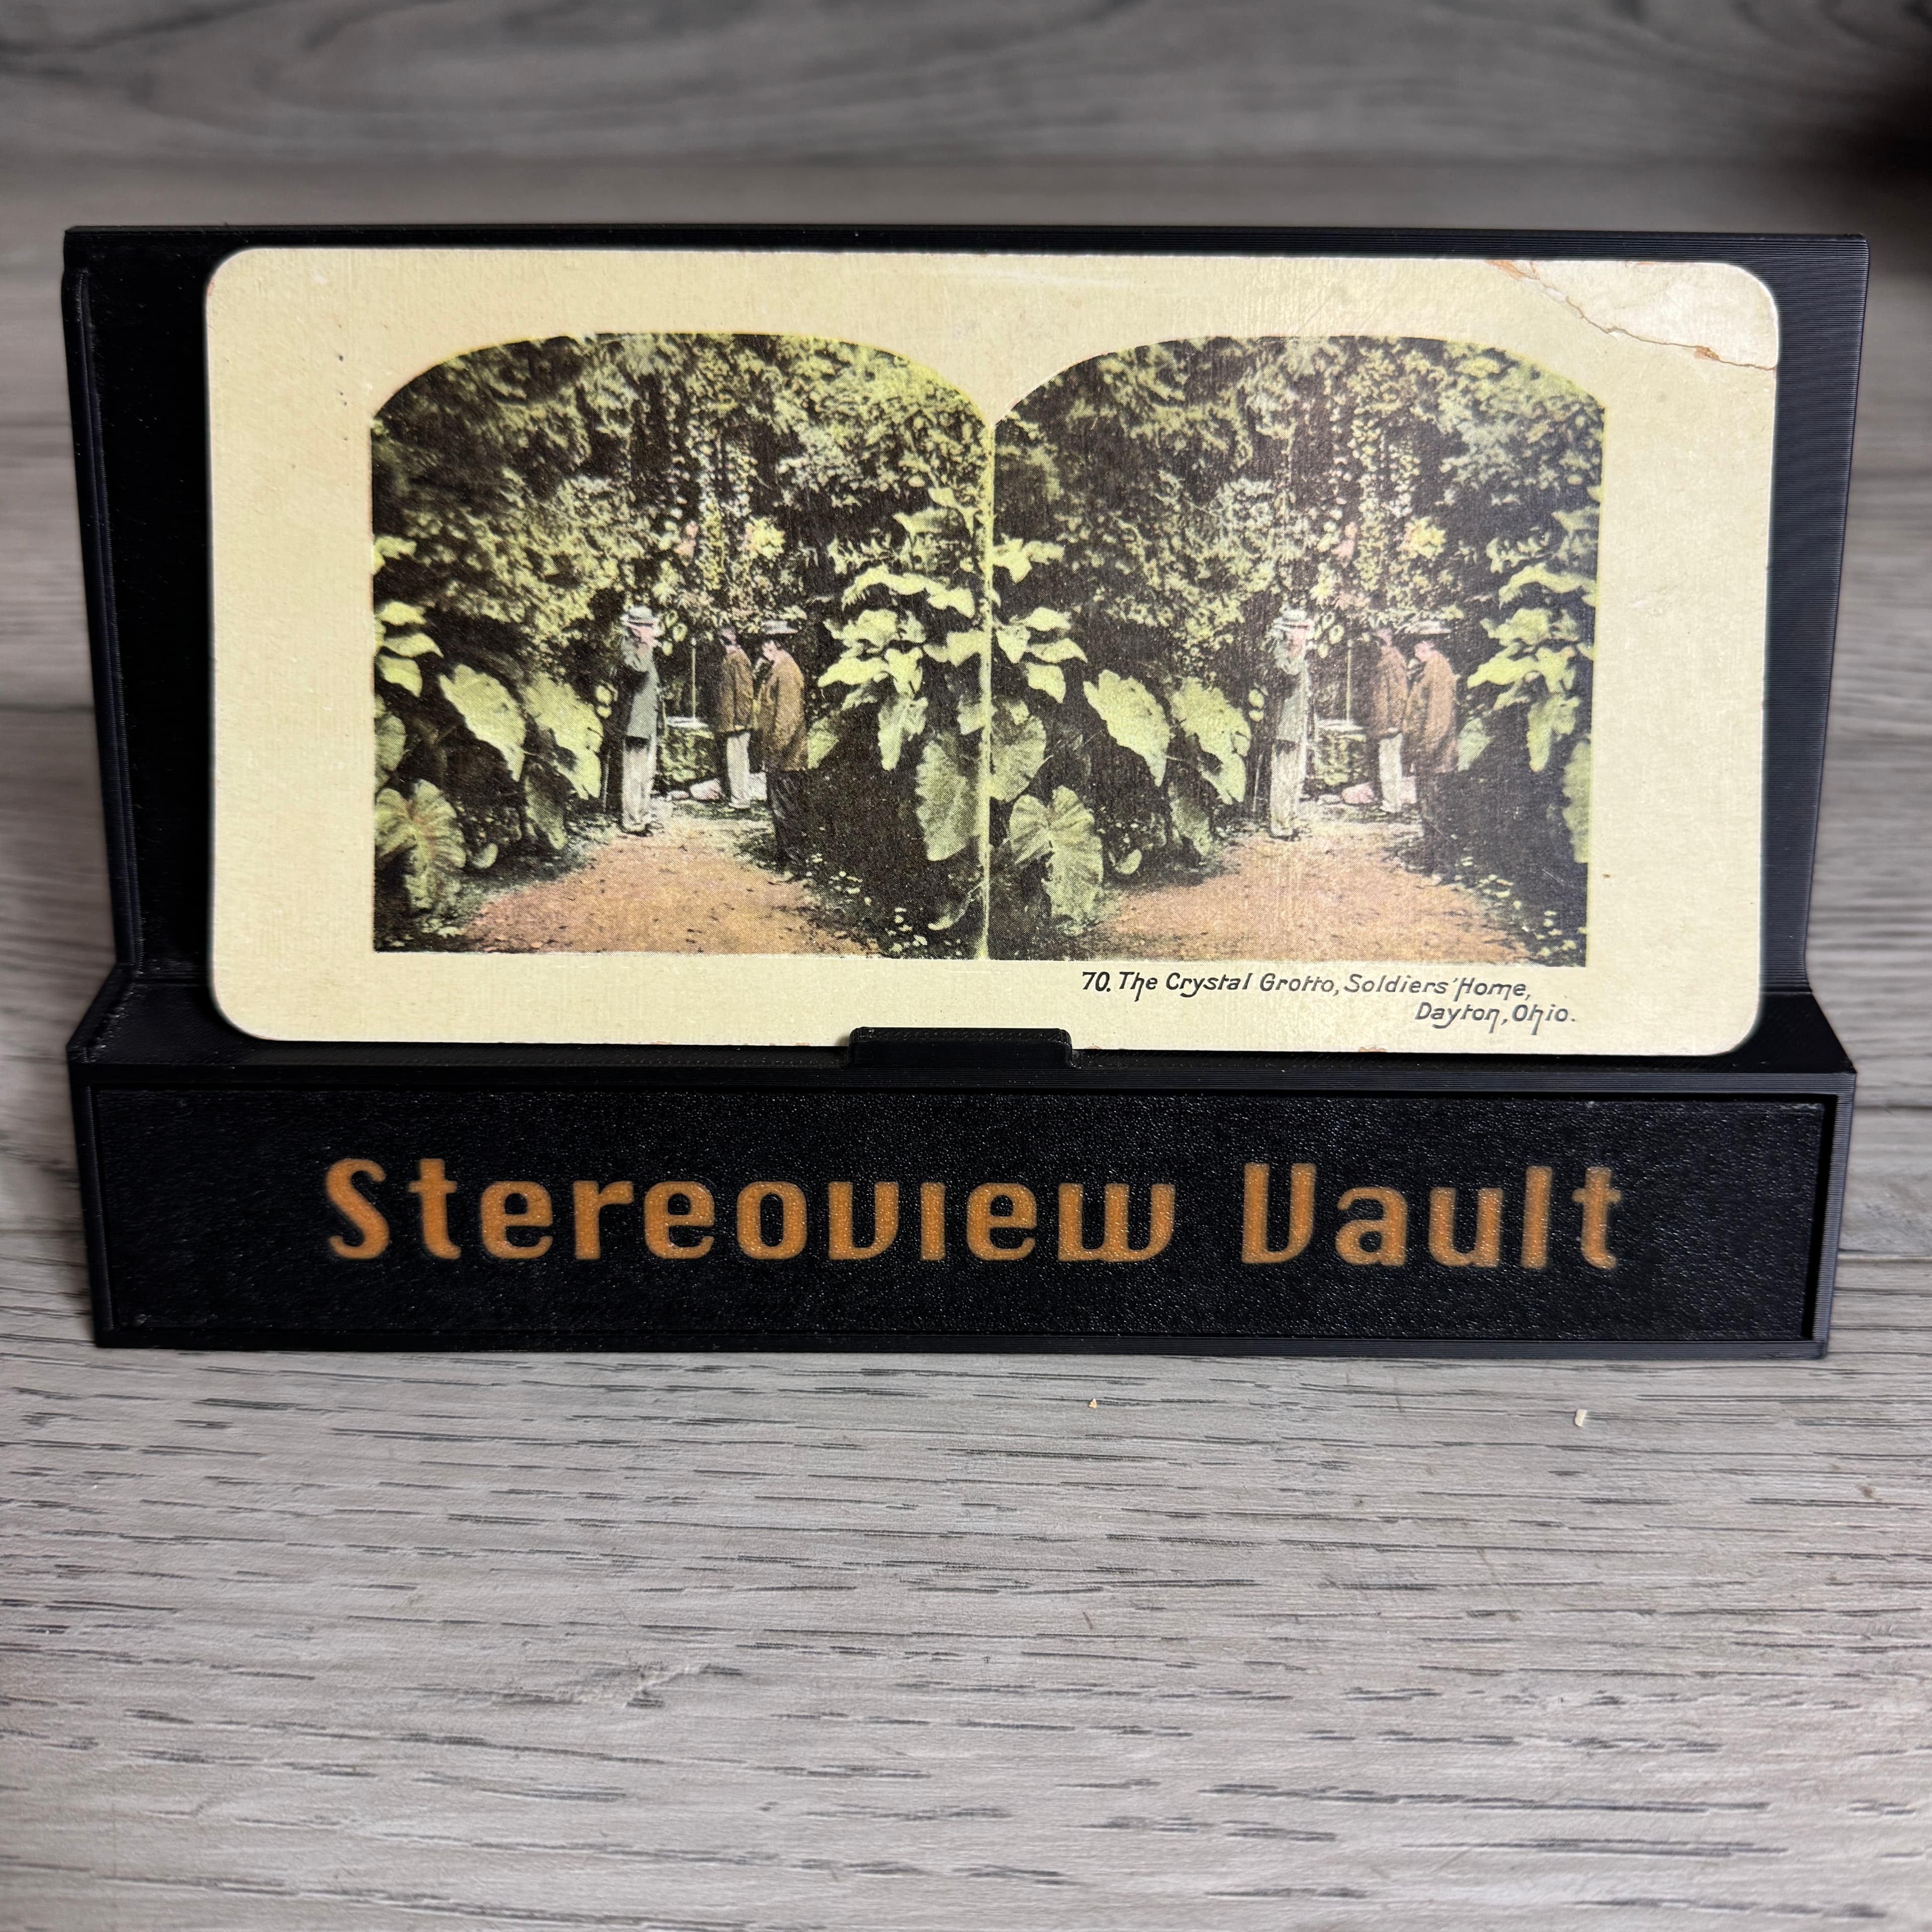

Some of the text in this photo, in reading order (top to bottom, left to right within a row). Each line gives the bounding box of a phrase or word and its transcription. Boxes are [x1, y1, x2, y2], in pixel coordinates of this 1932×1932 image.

[1082, 972, 1531, 1002] 70. The Crystal Grotto, Soldiers' Home,
[1414, 1001, 1576, 1035] Dayton, Ohio.
[324, 1157, 1622, 1269] Stereoview Vault
